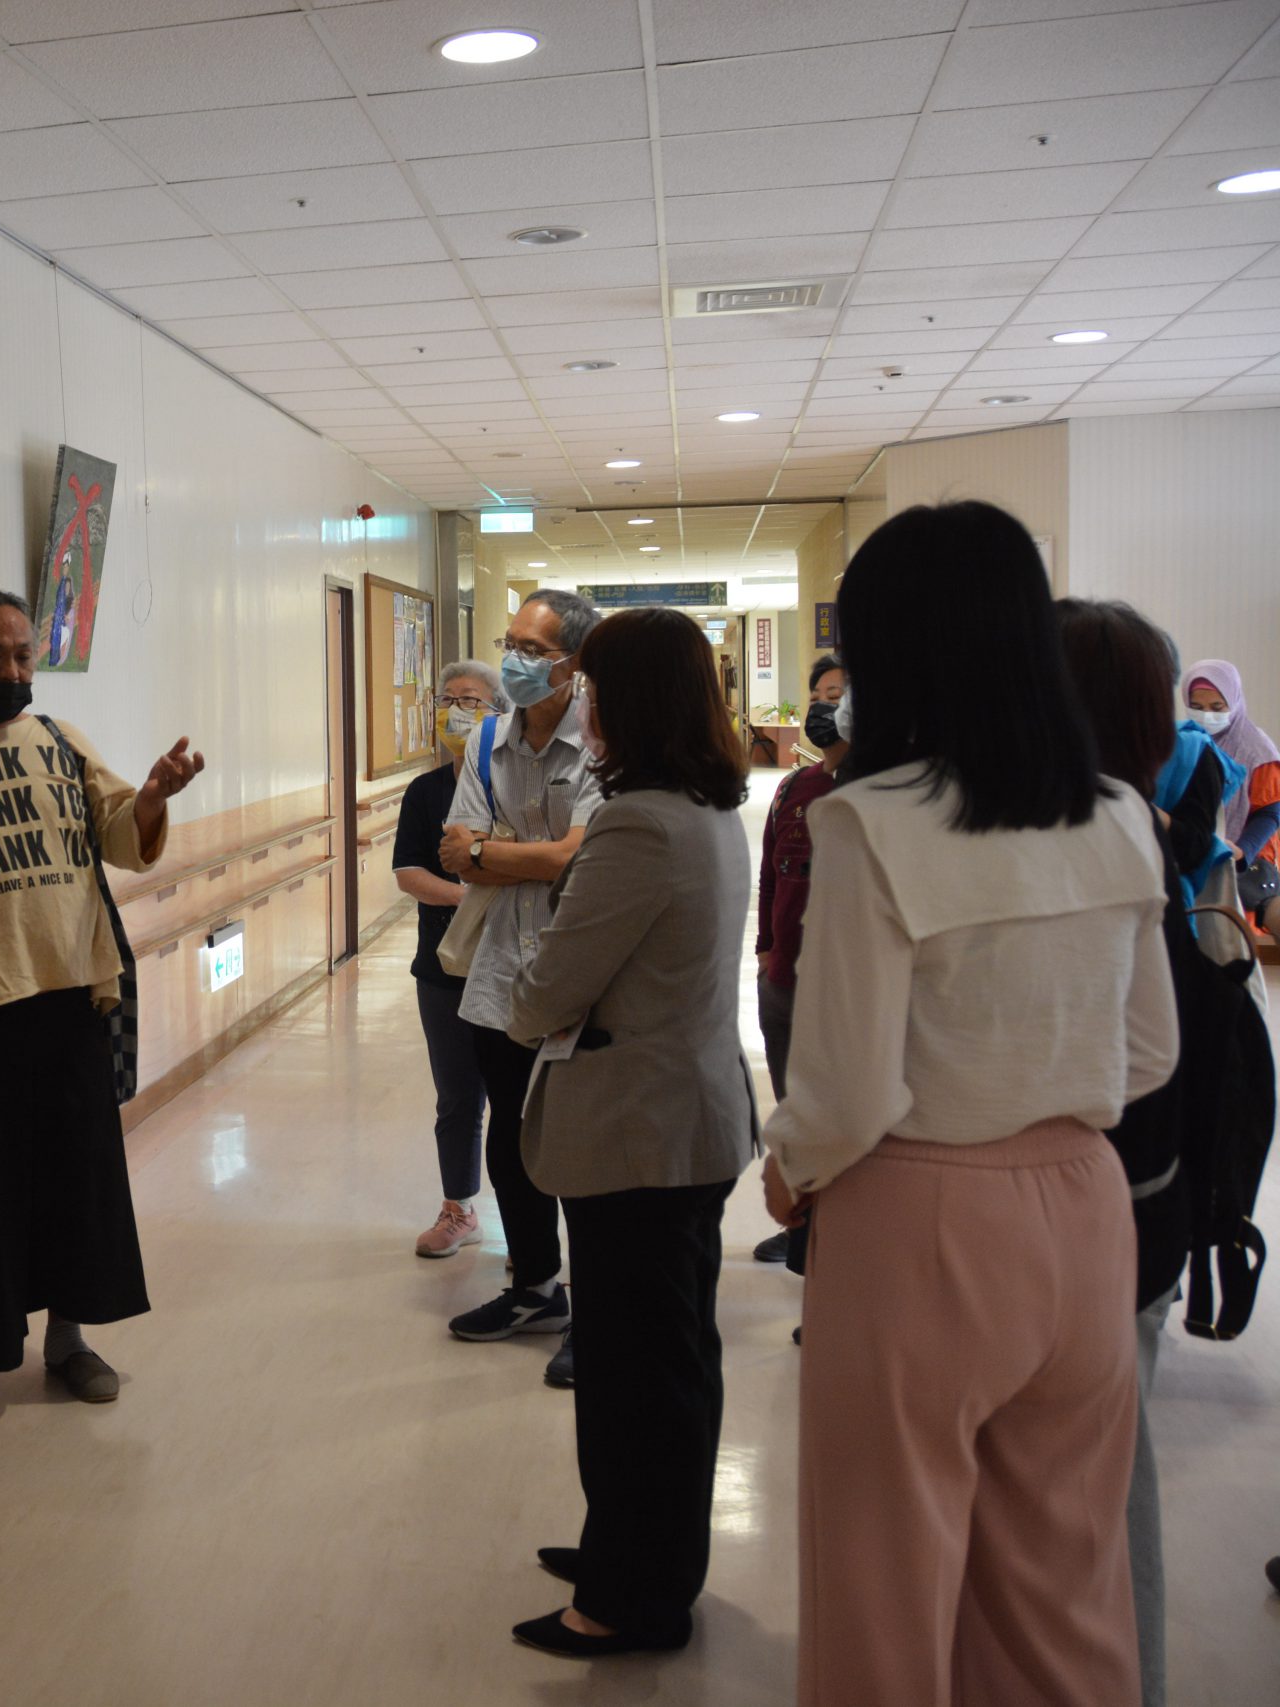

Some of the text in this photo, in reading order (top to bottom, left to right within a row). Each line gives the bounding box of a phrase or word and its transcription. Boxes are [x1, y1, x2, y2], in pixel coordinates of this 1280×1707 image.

[36, 745, 78, 780] YO
[46, 783, 86, 821] YO
[27, 876, 36, 889] A
[39, 873, 62, 886] NICE
[63, 872, 75, 884] DA
